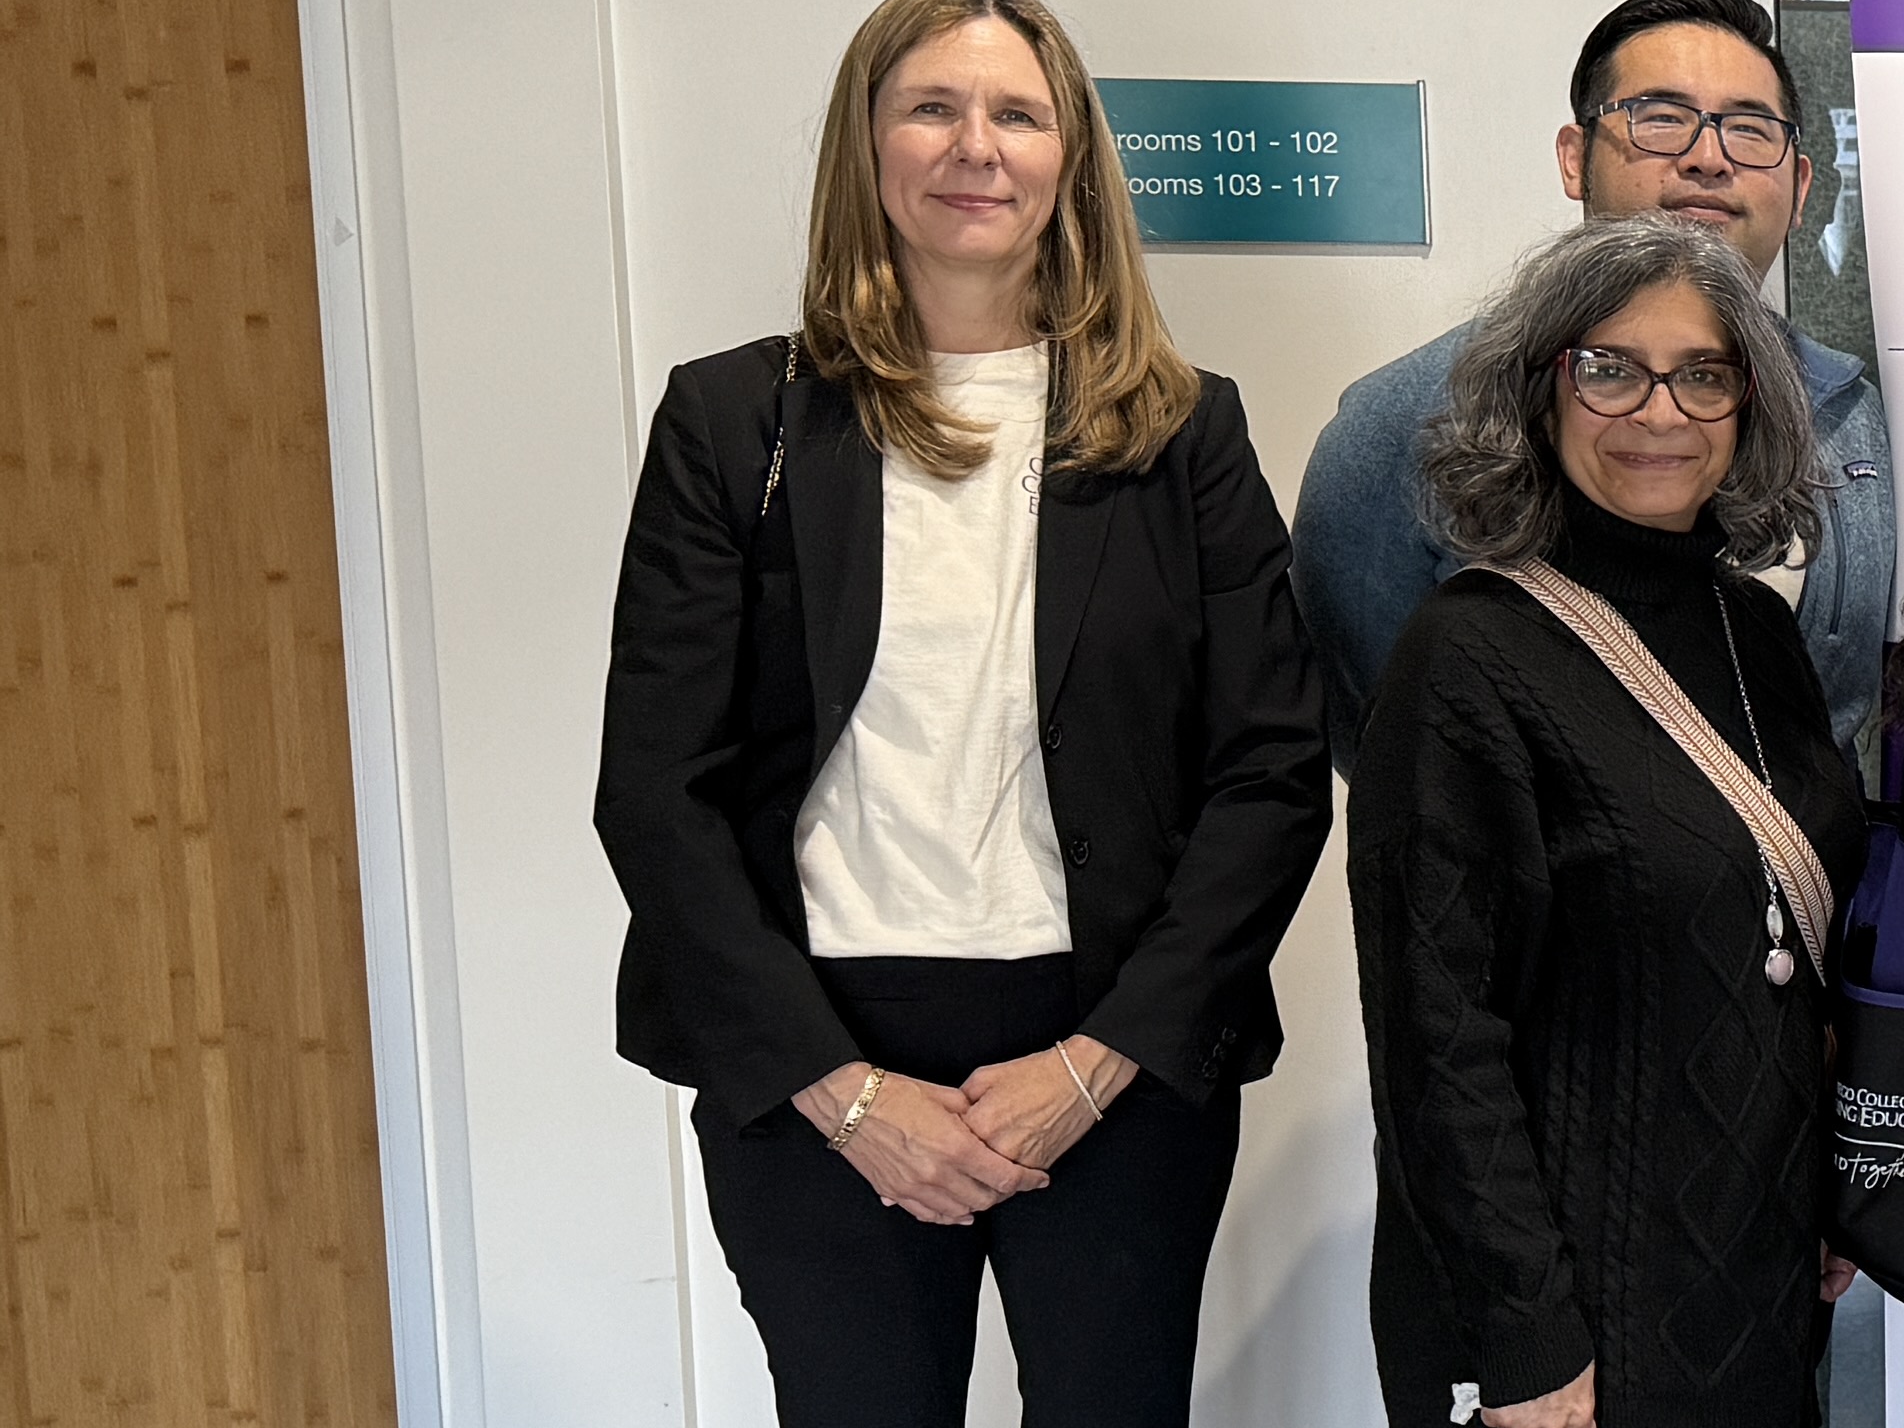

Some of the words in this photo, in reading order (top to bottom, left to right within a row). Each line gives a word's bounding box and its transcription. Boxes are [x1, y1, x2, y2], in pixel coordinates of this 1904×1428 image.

[1212, 131, 1257, 152] 101
[1291, 131, 1338, 154] 102
[1214, 174, 1262, 196] 103
[1292, 175, 1340, 197] 117
